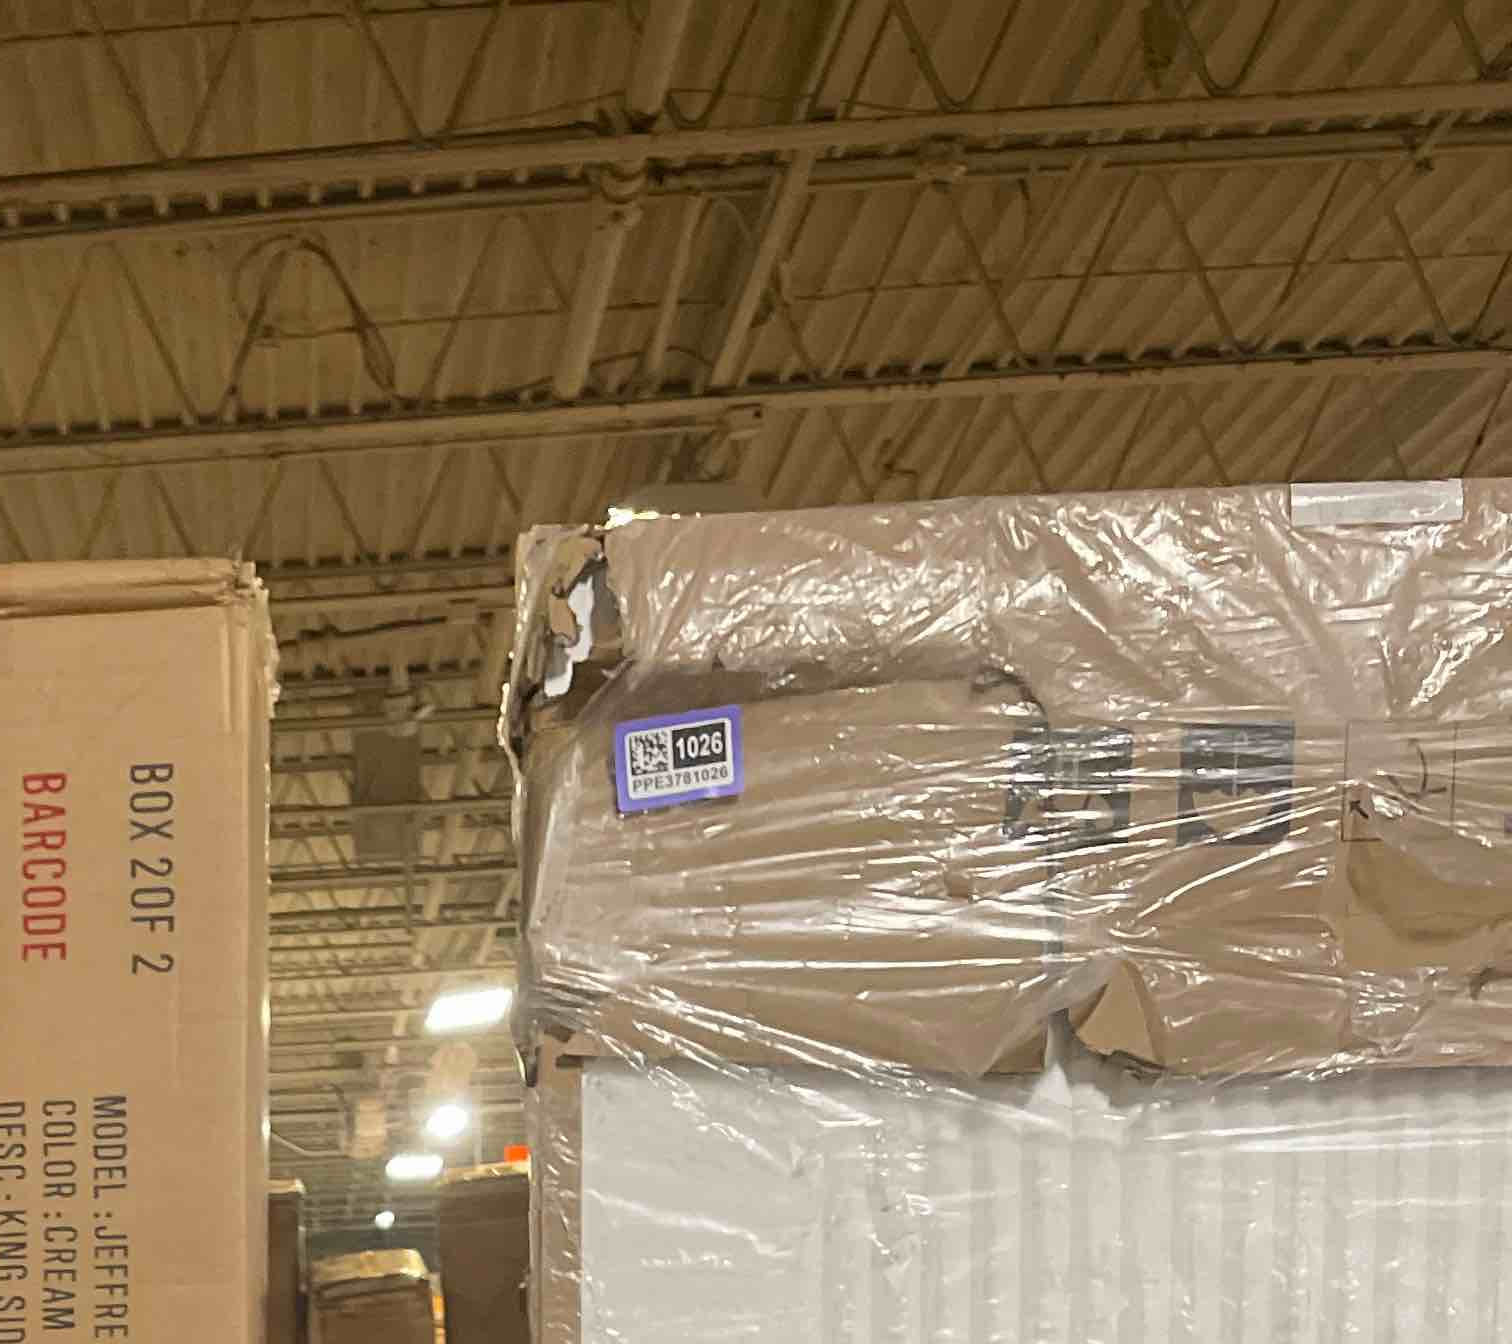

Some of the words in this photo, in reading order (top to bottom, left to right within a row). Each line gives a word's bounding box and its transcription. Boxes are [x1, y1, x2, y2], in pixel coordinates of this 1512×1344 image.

[675, 731, 724, 760] 1026
[129, 762, 176, 842] BOX
[20, 771, 69, 964] BARCODE
[130, 951, 176, 976] 2
[41, 1099, 78, 1200] COLOR
[92, 1095, 128, 1200] MODEL
